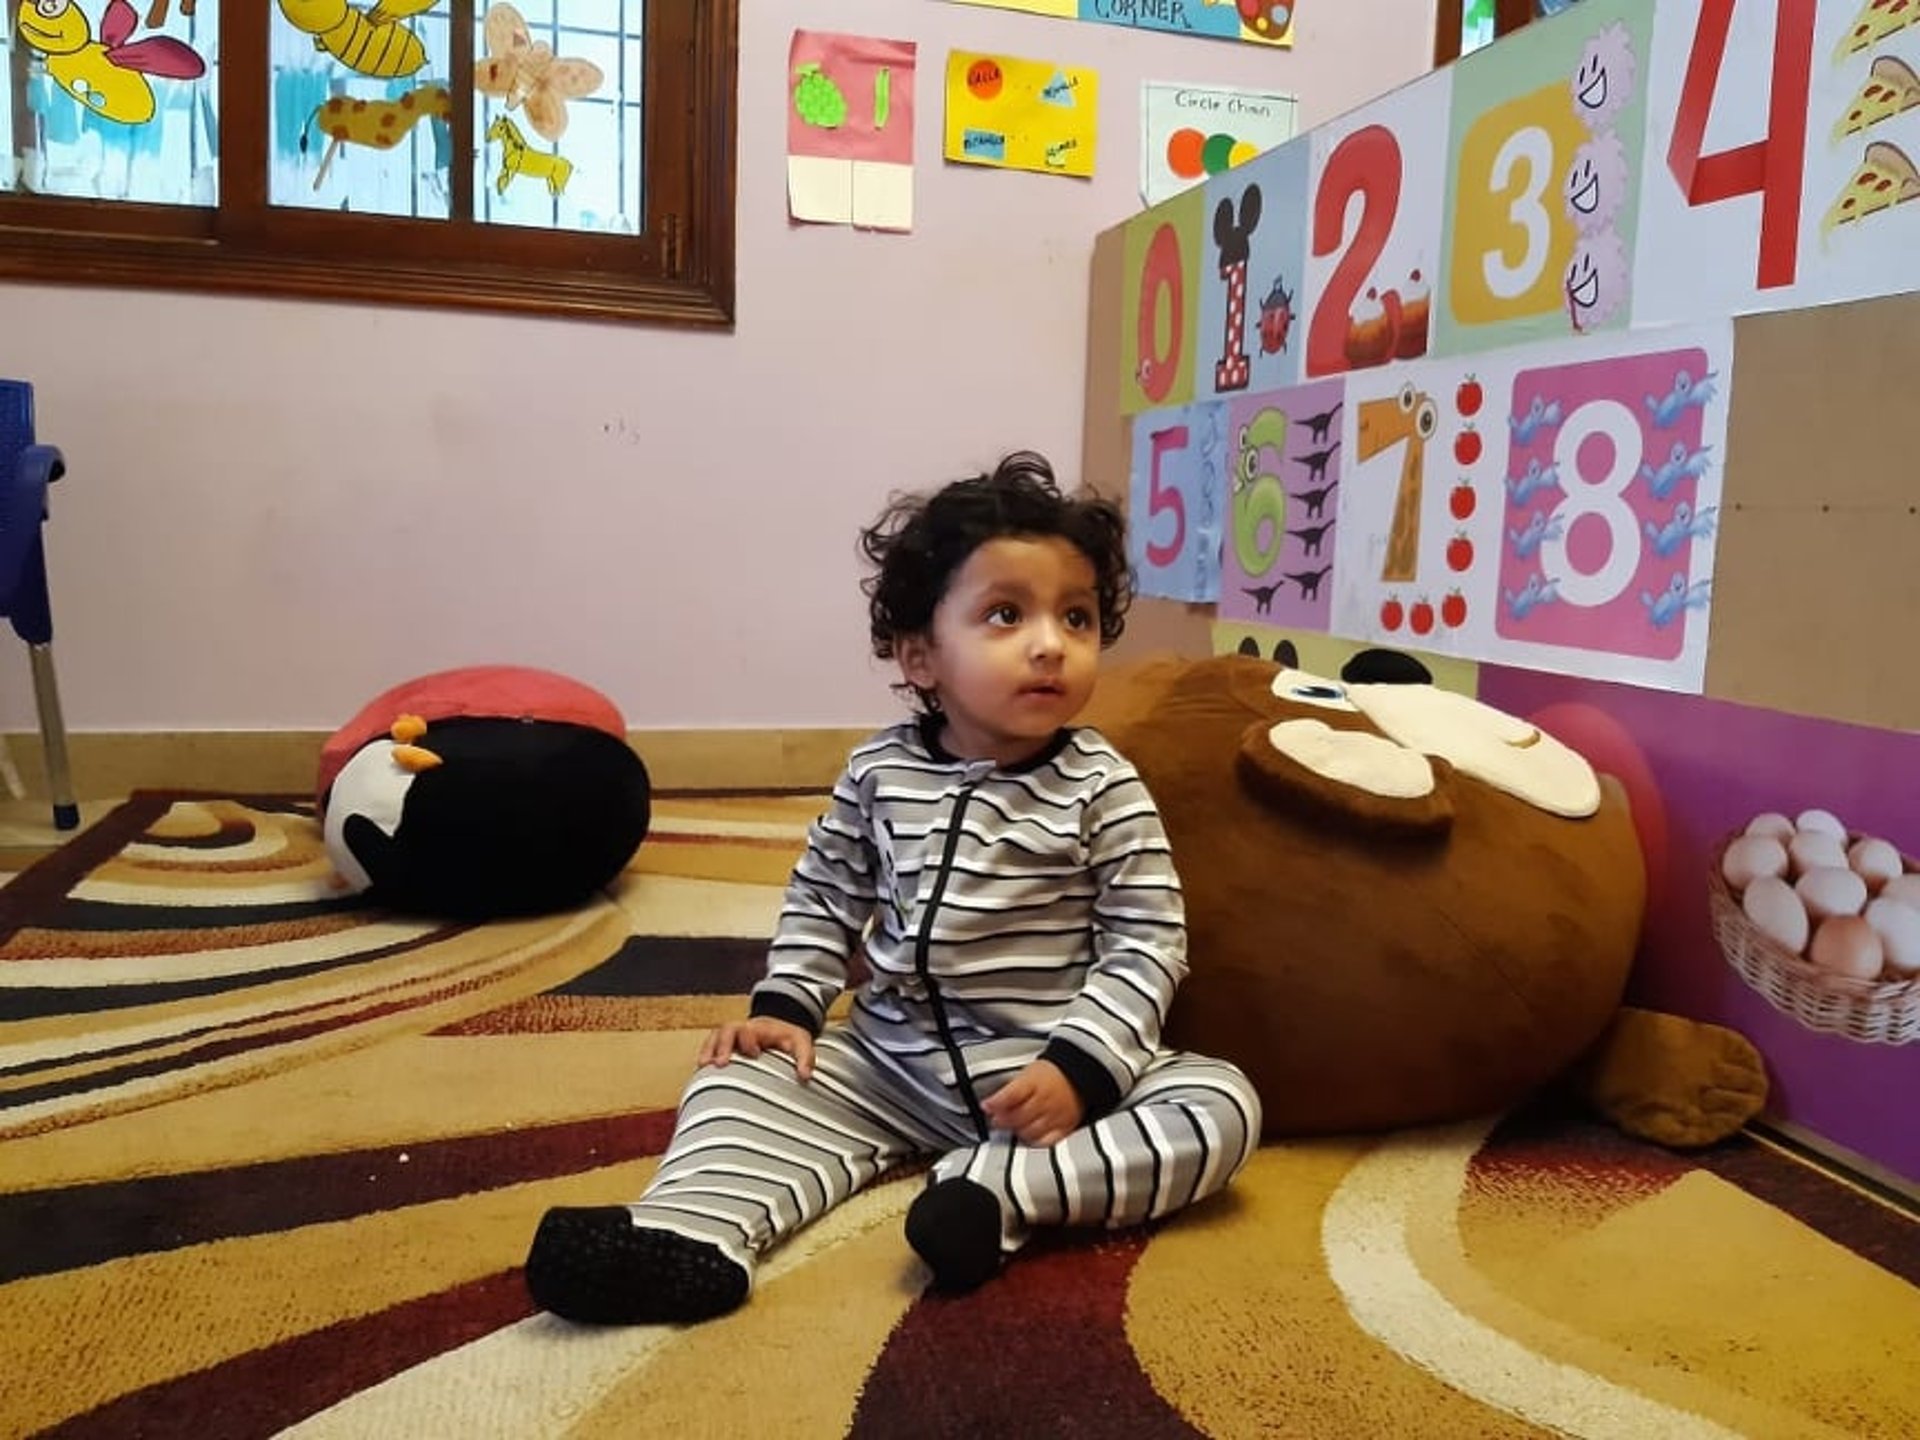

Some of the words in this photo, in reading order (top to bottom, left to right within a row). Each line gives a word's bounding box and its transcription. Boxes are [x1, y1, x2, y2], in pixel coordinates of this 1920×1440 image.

[1095, 0, 1192, 29] CORNER
[1482, 126, 1554, 299] 3
[1667, 0, 1817, 291] 4
[1137, 222, 1183, 402] 0
[1214, 205, 1256, 393] 1
[1305, 124, 1403, 378] 2
[1145, 426, 1189, 567] 5
[1234, 407, 1287, 578] 6
[1357, 385, 1435, 582] 7
[1541, 400, 1643, 607] 8
